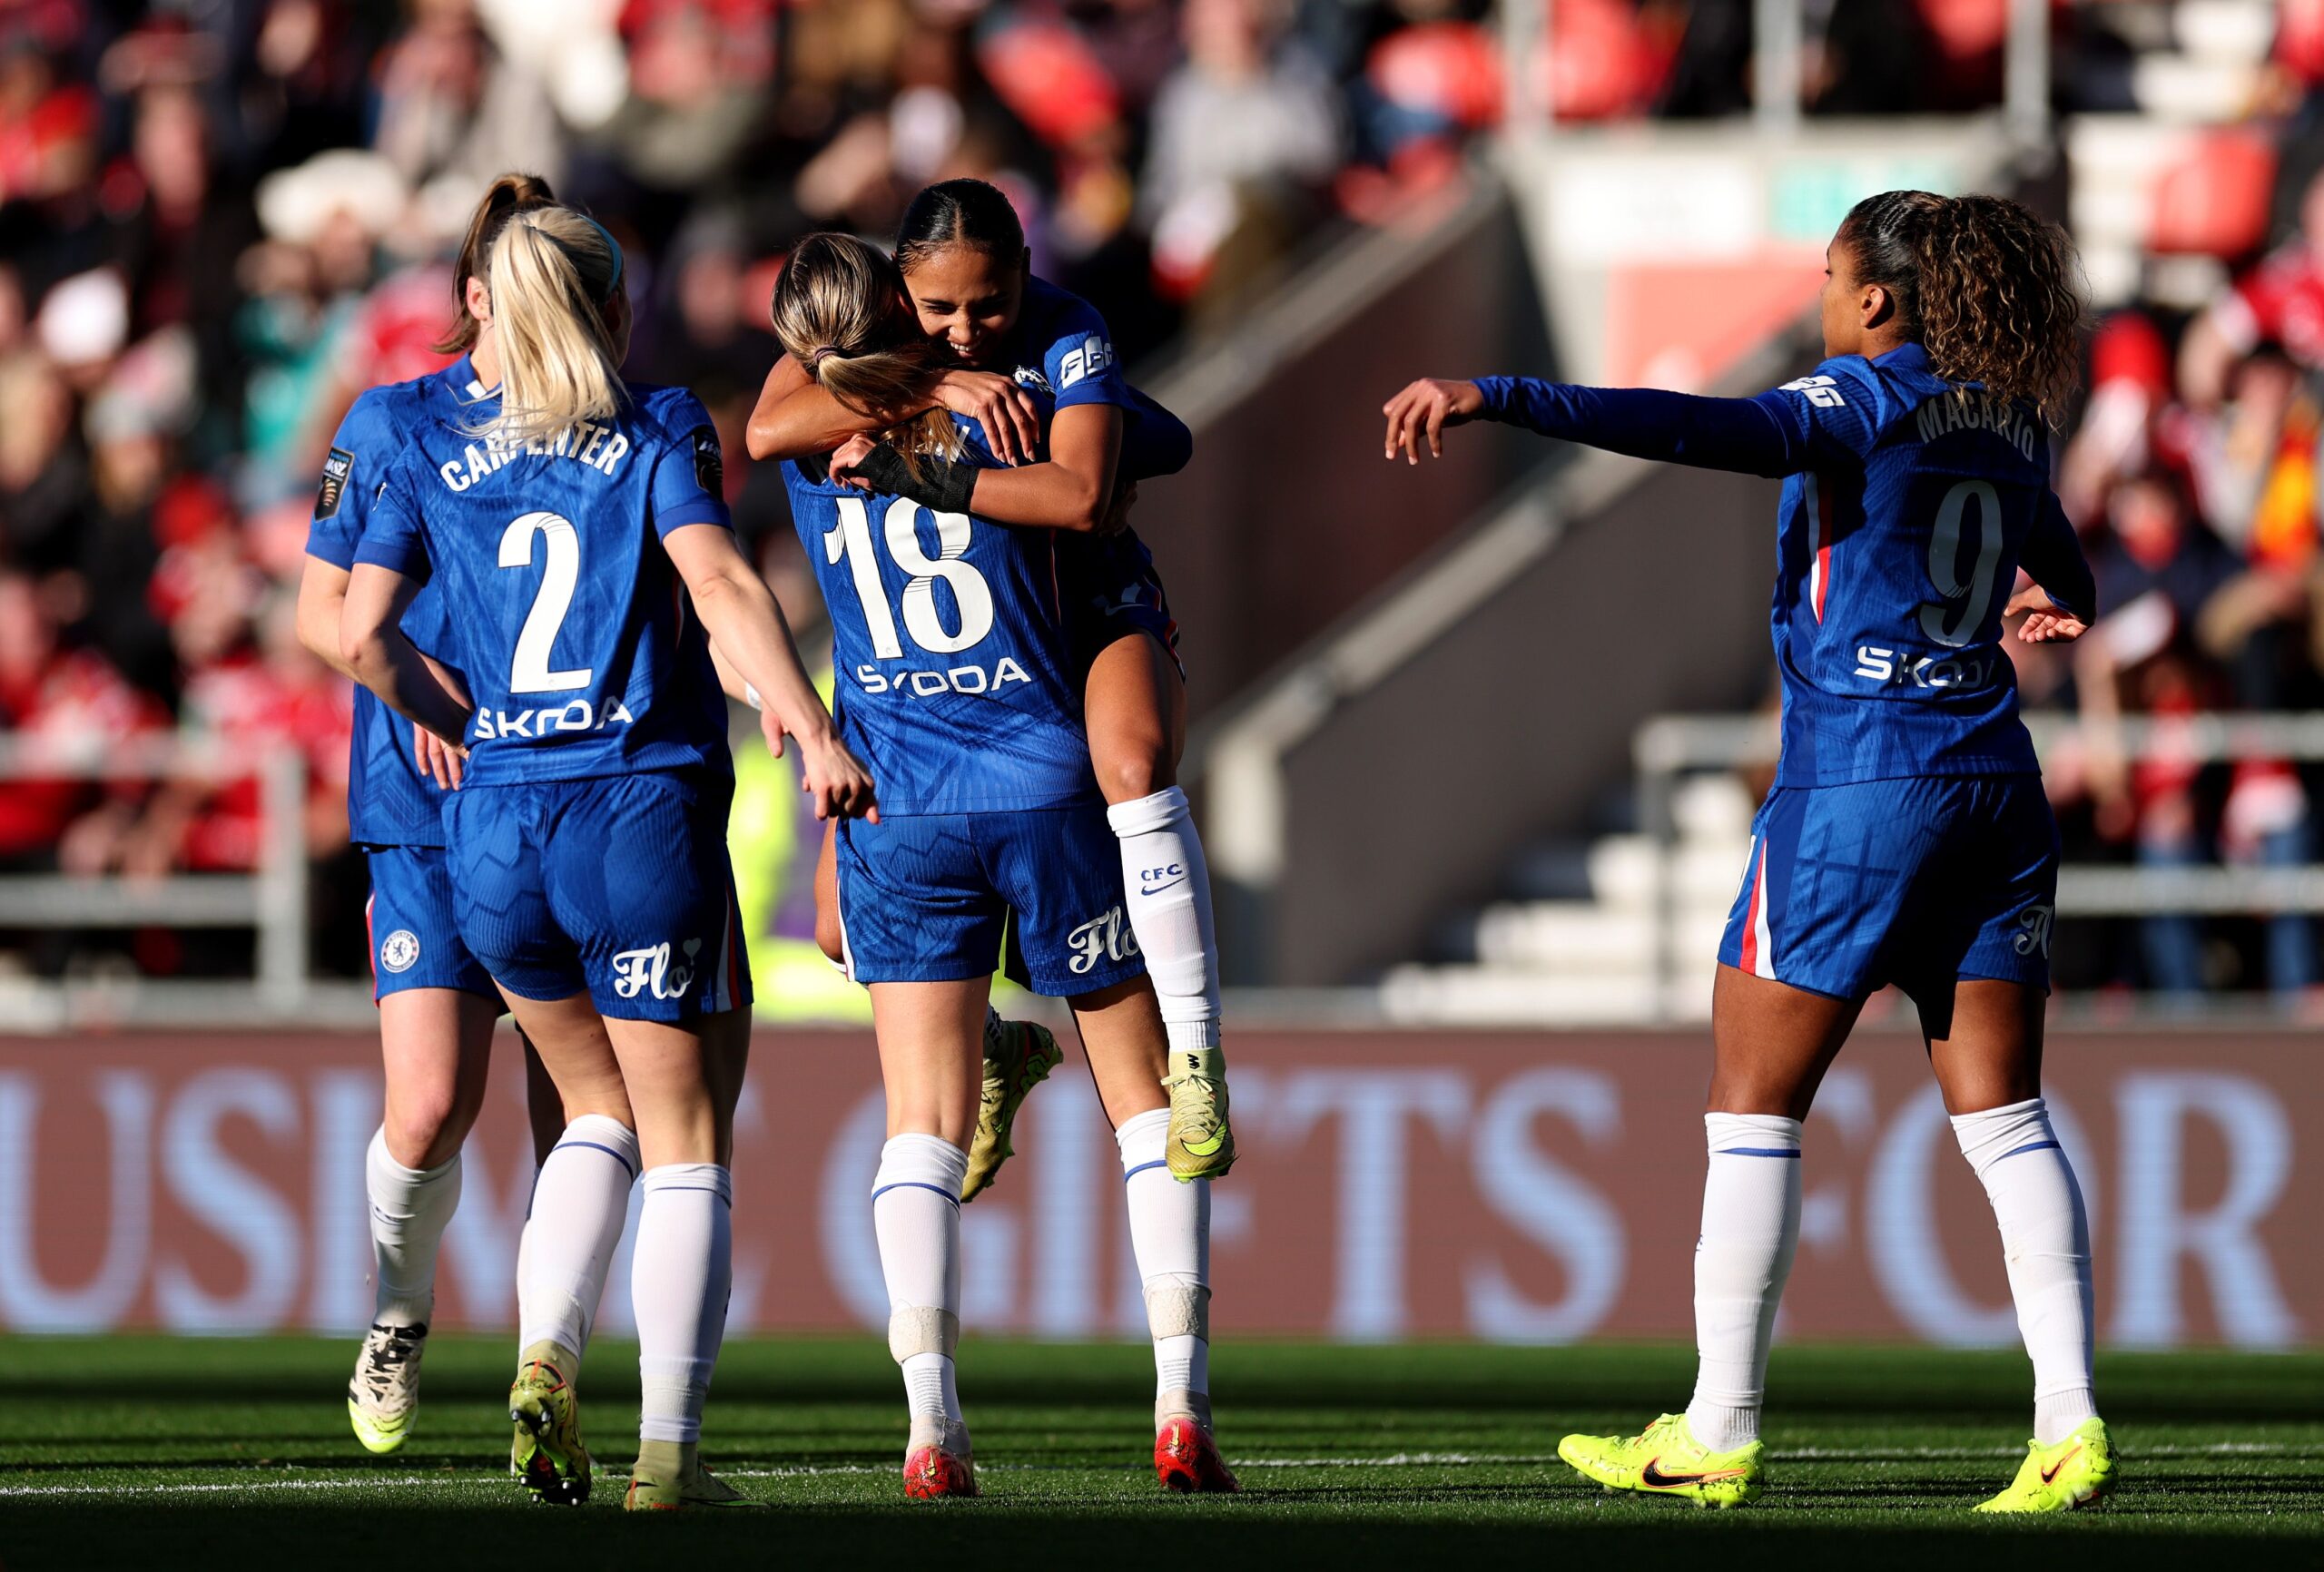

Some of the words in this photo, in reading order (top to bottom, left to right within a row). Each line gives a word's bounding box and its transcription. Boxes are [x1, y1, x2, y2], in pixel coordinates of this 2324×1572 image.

[497, 511, 593, 693] 2
[823, 496, 994, 660] 18
[1919, 480, 2003, 647] 9
[1141, 863, 1183, 881] CFC
[613, 941, 694, 999] Flo
